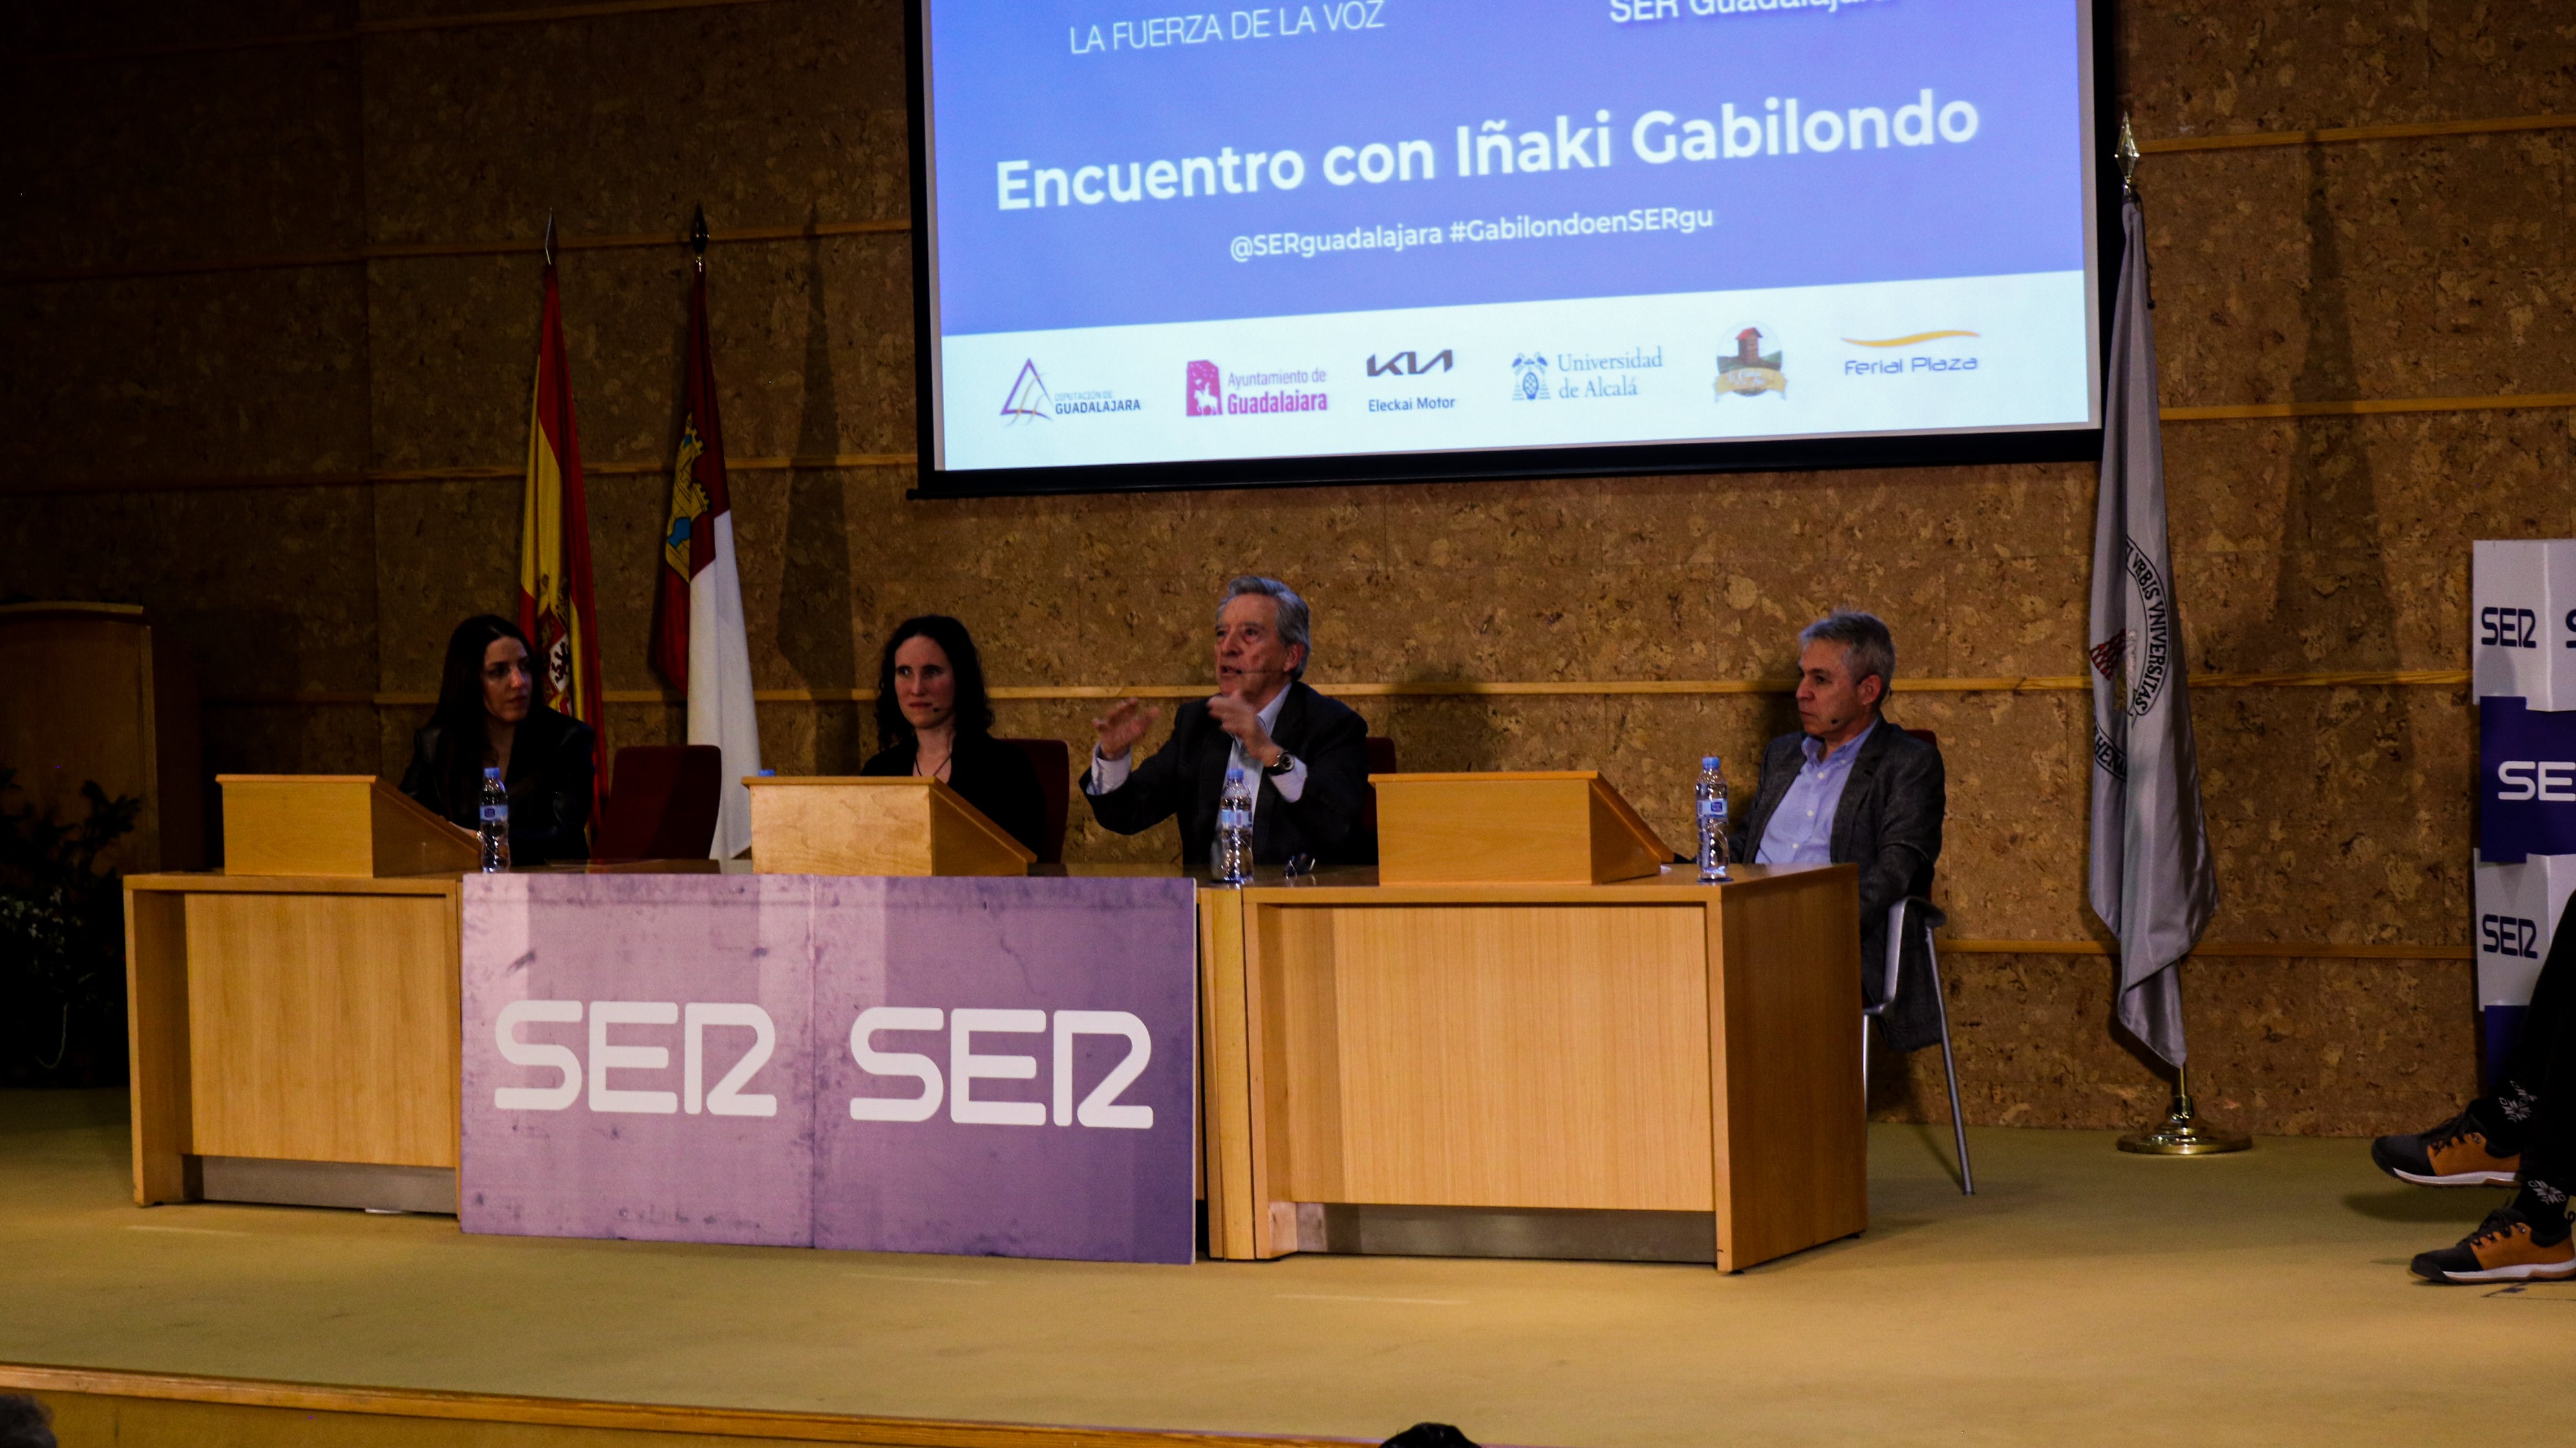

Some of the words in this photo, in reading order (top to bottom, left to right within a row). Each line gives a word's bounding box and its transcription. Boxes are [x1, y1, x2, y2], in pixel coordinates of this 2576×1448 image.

[1610, 0, 1679, 23] SER
[1070, 25, 1105, 54] LA
[1113, 14, 1223, 50] FUERZA
[1231, 9, 1271, 39] DE
[1280, 6, 1316, 36] LA
[1324, 0, 1385, 31] VOZ
[997, 147, 1305, 210] Encuentro
[1323, 138, 1434, 186] con
[1457, 109, 1611, 176] Iñaki
[1631, 89, 1980, 164] Gabilondo
[1230, 224, 1443, 262] @SERguadalajara
[1450, 207, 1713, 242] #GabilondoenSERgu
[1366, 349, 1453, 377] KIA
[1558, 345, 1663, 372] Universidad
[1845, 358, 1903, 375] Ferial
[1911, 357, 1978, 372] Plaza
[1228, 370, 1308, 390] Ayuntamiento
[1312, 367, 1326, 383] de
[1559, 378, 1579, 398] de
[1584, 375, 1638, 398] Alcalá
[1055, 399, 1141, 414] GUADALAJARA
[1369, 398, 1413, 412] Eleckai
[1417, 397, 1455, 409] Motor
[2482, 606, 2537, 648] SER
[2482, 914, 2538, 959] SER
[494, 999, 777, 1116] SER
[850, 1006, 1154, 1129] SER
